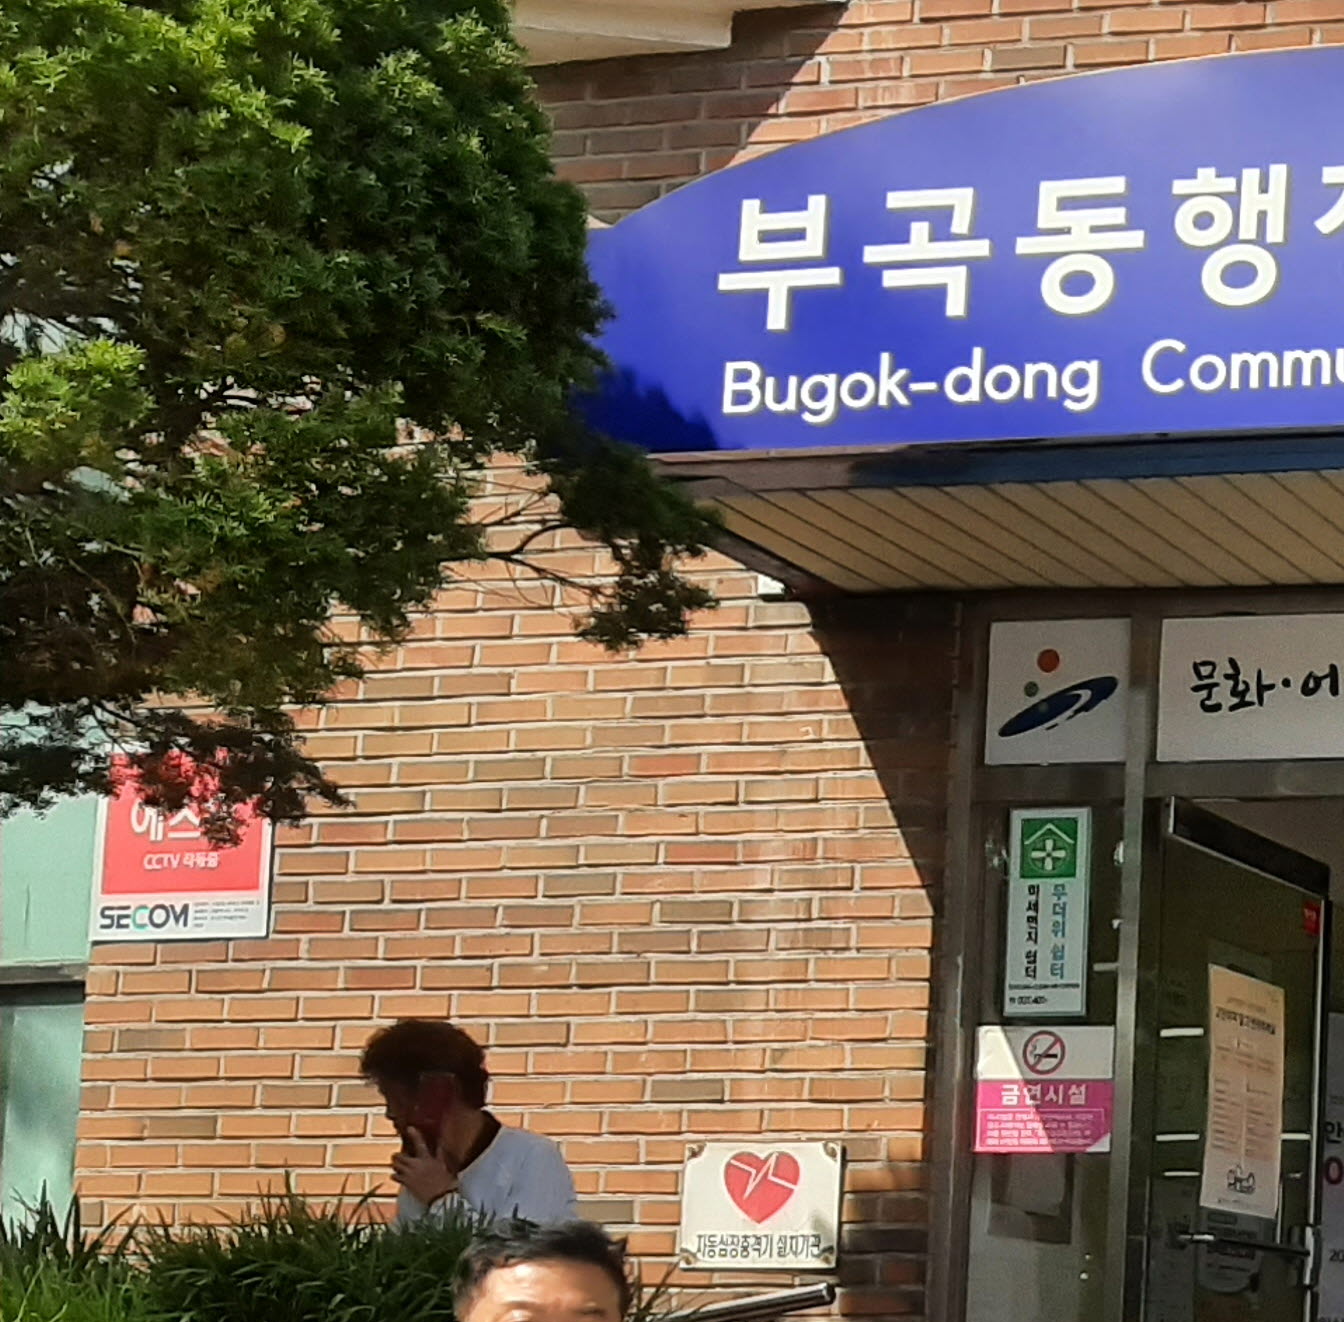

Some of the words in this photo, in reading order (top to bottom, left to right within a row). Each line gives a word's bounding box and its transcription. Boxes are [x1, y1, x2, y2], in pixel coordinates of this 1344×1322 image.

[722, 346, 1099, 425] Bugok-dong
[143, 853, 181, 870] CCTV
[99, 903, 190, 930] SECOM
[1001, 1083, 1087, 1106] 금연시설
[696, 1233, 773, 1259] 자동심장충격기
